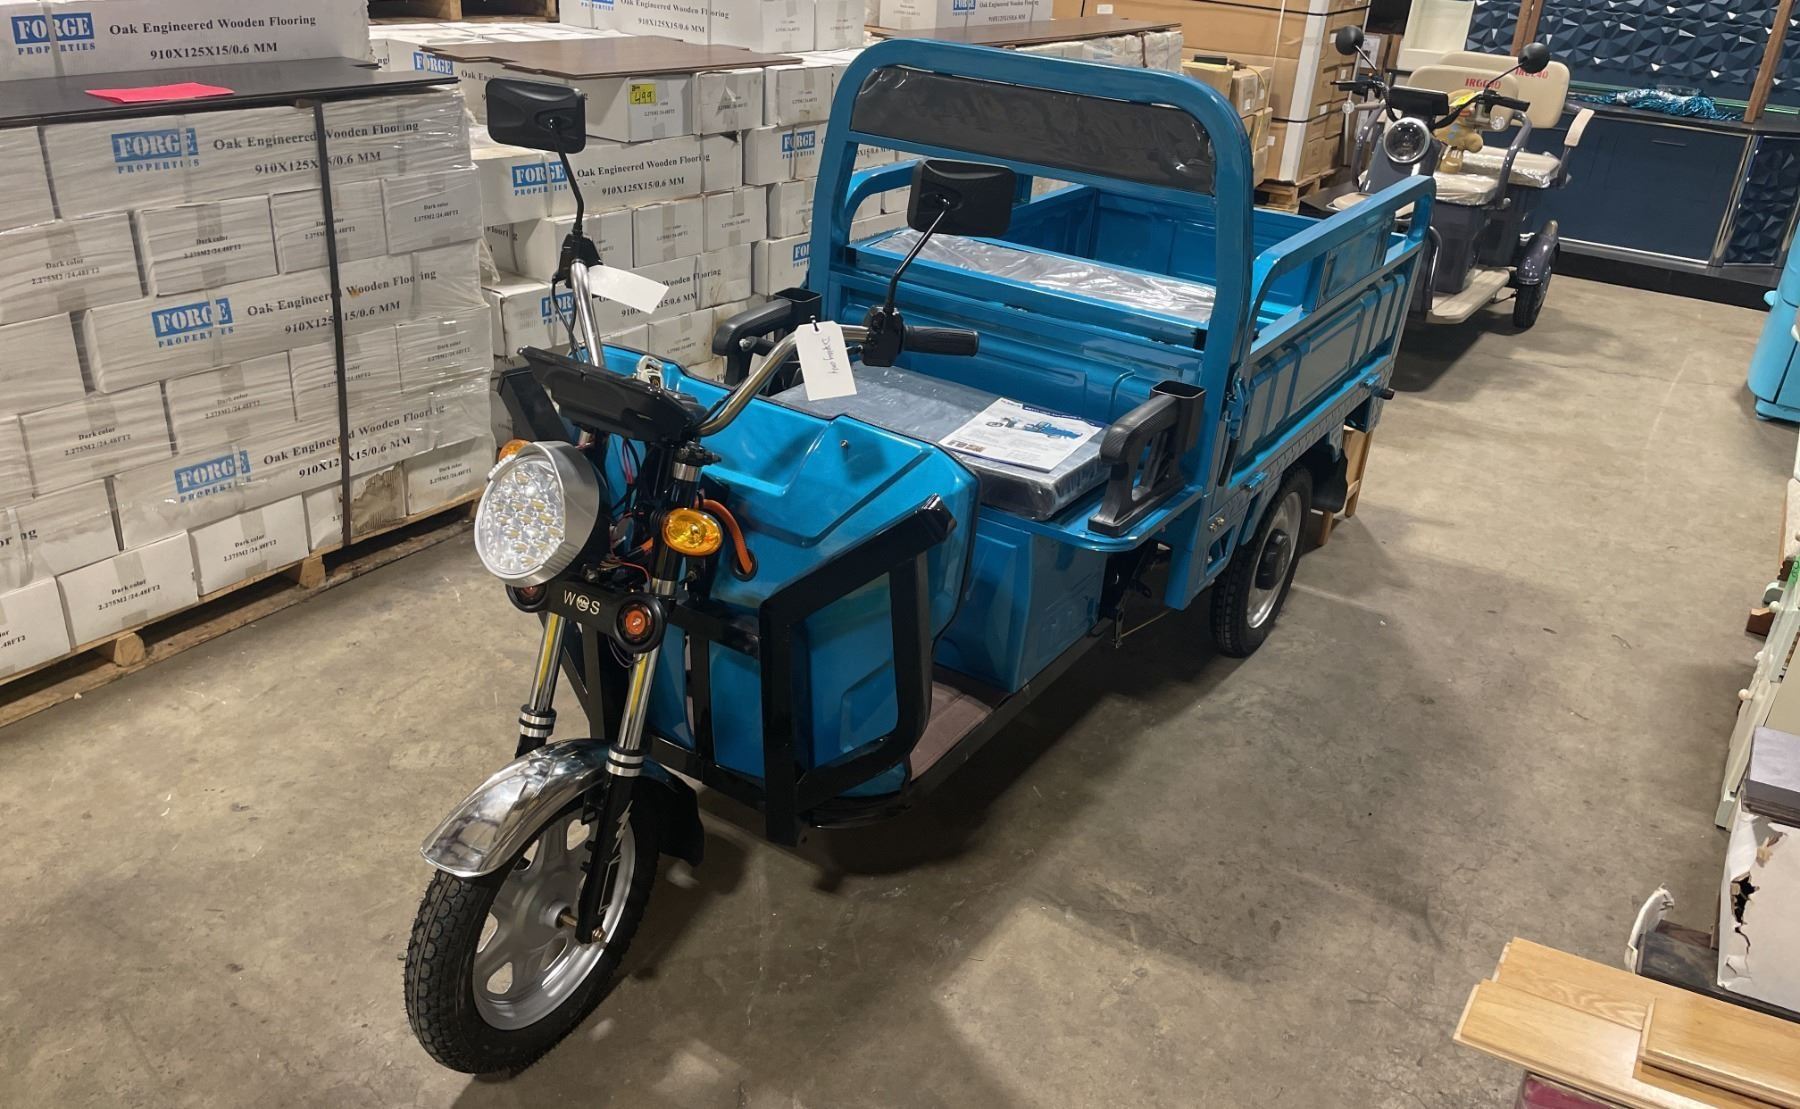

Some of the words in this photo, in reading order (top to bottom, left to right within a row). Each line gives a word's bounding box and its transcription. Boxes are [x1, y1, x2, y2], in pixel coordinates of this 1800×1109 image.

[673, 3, 699, 14] Wooden
[700, 7, 730, 19] Floring
[17, 17, 91, 40] FORGE
[109, 24, 138, 35] Oak
[143, 19, 214, 35] Engineered
[218, 17, 265, 29] Wooden
[269, 15, 317, 26] Flooring
[17, 42, 96, 55] PROPRTIES
[150, 44, 250, 60] 910X125X15/0.6
[253, 42, 278, 53] MM
[116, 132, 195, 157] FORGE
[213, 135, 242, 150] Oak
[247, 131, 318, 148] Engineered
[118, 158, 200, 174] PROPERTIS
[255, 153, 354, 175] 910X125X5/0.6
[358, 151, 382, 163] MM
[577, 168, 596, 178] Oak
[598, 162, 645, 176] Engineered
[646, 158, 678, 170] Wooden
[514, 184, 568, 197] PROPERIES
[602, 179, 667, 196] 910X125X15/0.6
[668, 176, 685, 186] MM
[247, 304, 274, 317] Oak
[346, 280, 390, 298] Wooden
[393, 270, 437, 290] Flooing
[683, 291, 698, 301] MM
[284, 307, 375, 335] 910X12515/0.6
[379, 300, 401, 313] MM
[158, 326, 235, 348] PROPERTES
[78, 430, 97, 441] Dark
[97, 426, 116, 437] color
[263, 450, 289, 465] Oak
[358, 417, 400, 438] Wooden
[299, 443, 387, 479] 910X12X15/0.6
[390, 435, 412, 450] MM
[235, 539, 249, 548] Dark
[249, 533, 265, 543] color
[111, 585, 128, 596] Dark
[128, 578, 147, 590] color
